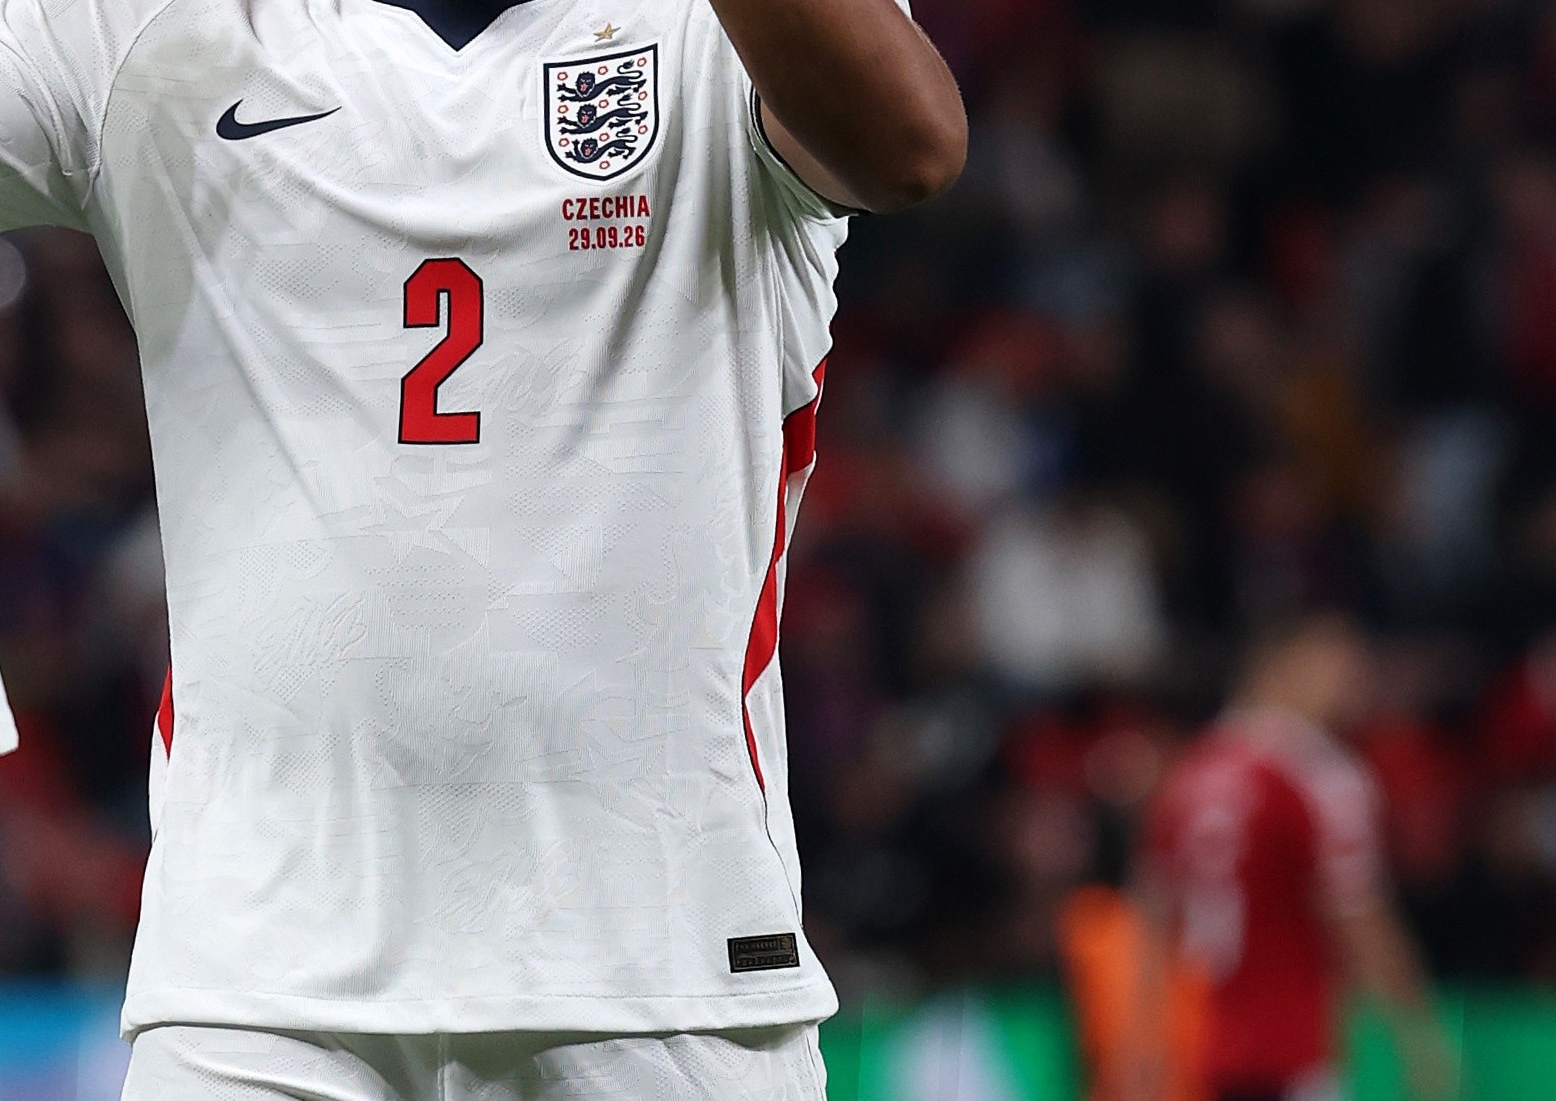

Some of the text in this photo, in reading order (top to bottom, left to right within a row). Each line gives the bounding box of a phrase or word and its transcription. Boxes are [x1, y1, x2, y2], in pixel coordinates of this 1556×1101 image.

[562, 194, 650, 221] CZECHIA
[568, 225, 645, 250] 29.09.26
[398, 257, 484, 444] 2
